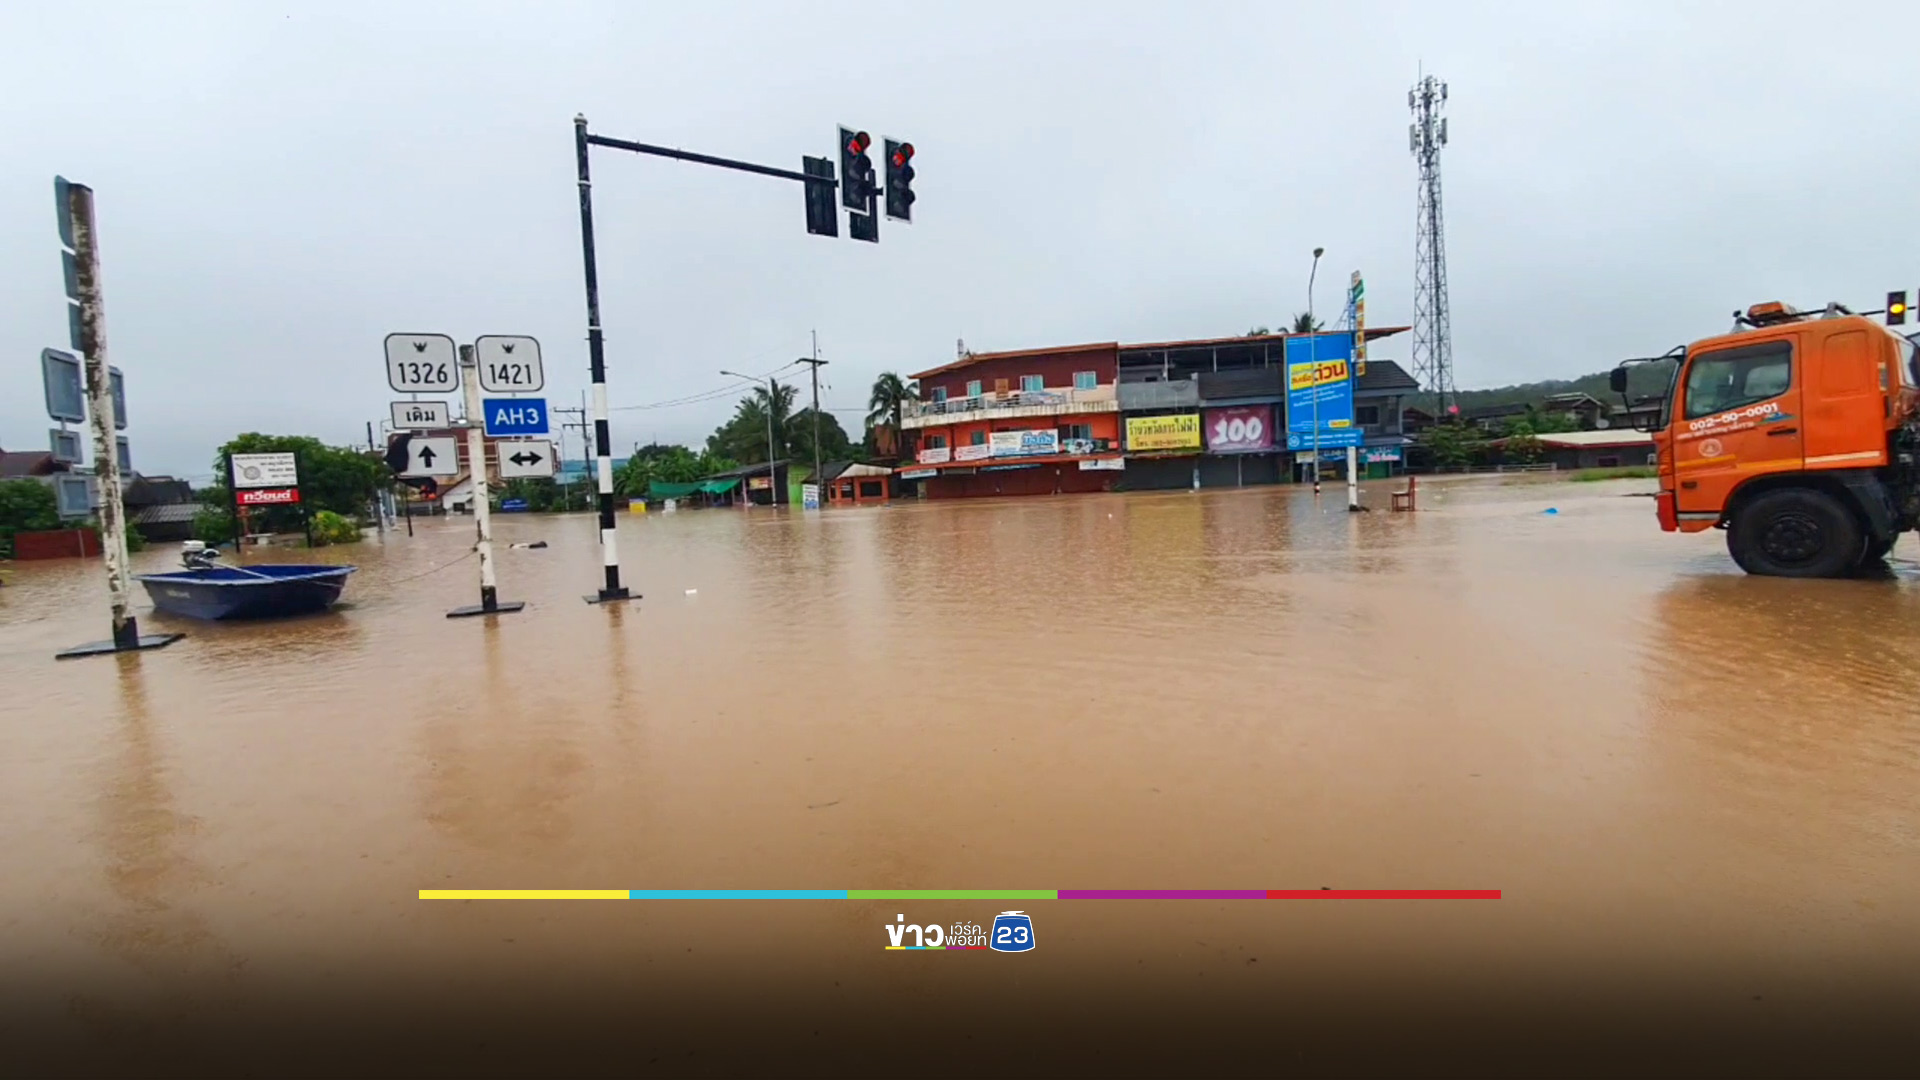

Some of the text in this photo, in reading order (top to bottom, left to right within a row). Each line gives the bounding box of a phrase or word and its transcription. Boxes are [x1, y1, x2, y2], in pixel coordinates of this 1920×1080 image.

[398, 362, 448, 384] 1326
[489, 363, 532, 384] 1421
[406, 407, 436, 422] เดิม
[494, 408, 540, 426] AH3
[1211, 416, 1263, 445] 100
